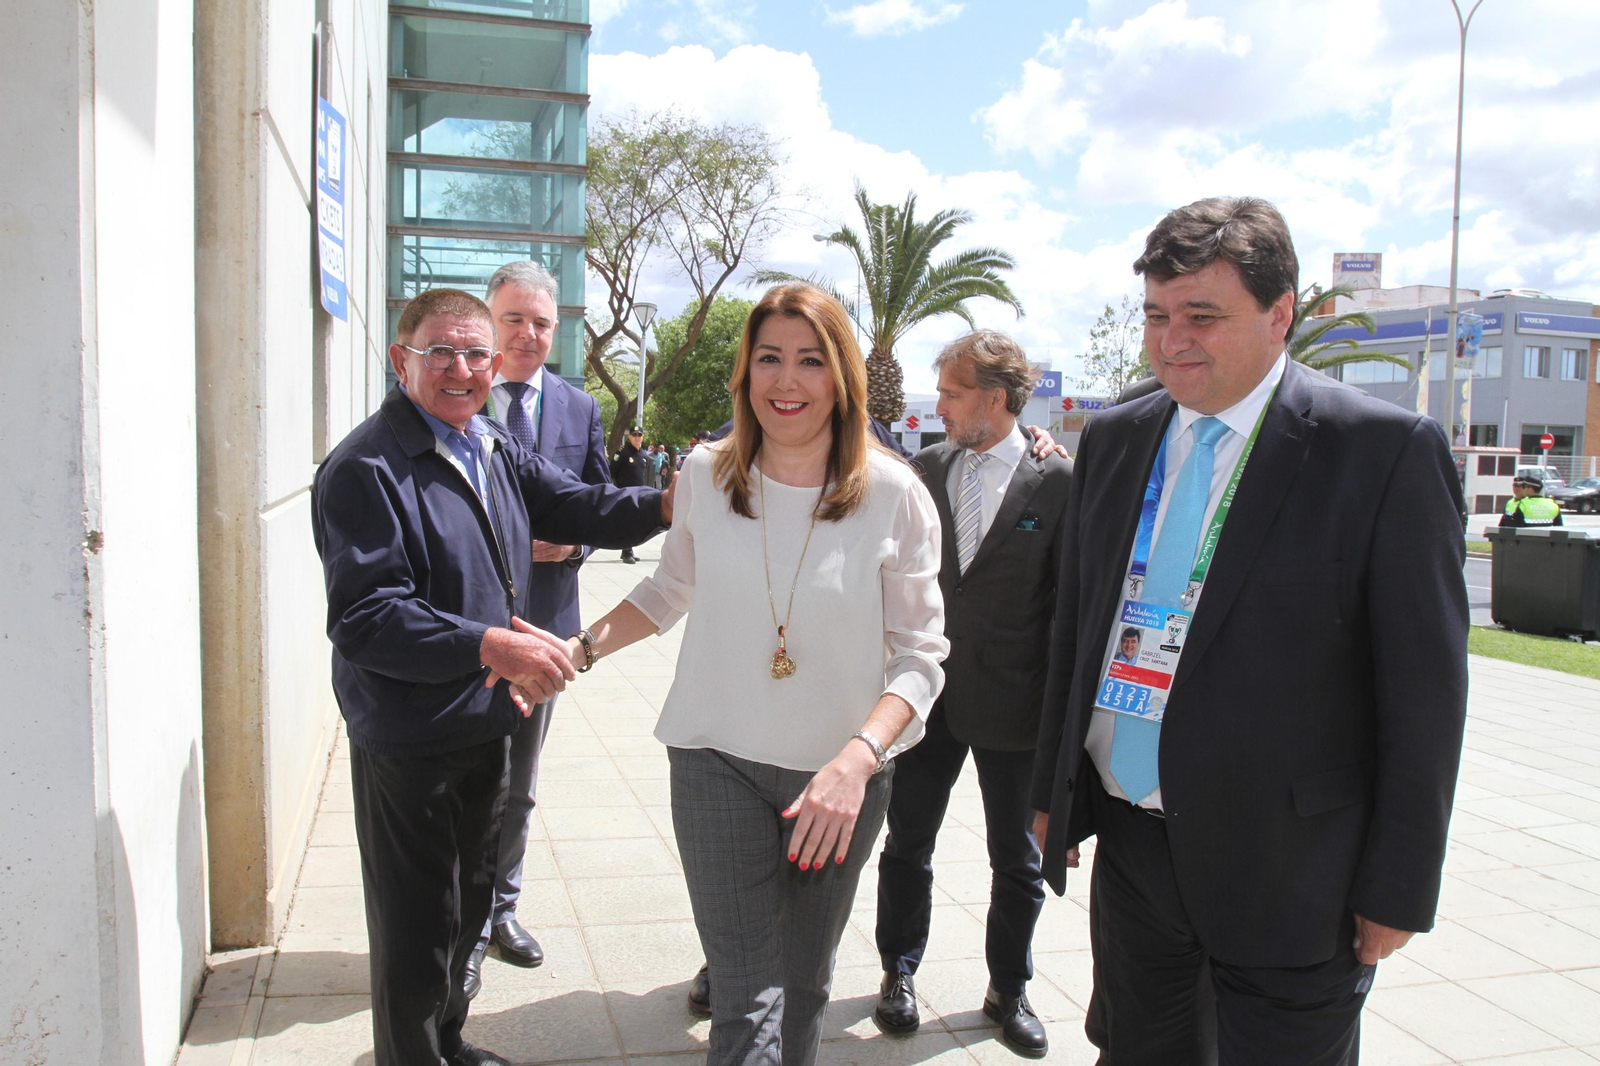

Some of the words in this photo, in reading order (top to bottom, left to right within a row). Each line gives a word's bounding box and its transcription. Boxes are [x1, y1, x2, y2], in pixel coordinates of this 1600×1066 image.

[1523, 317, 1550, 325] VOLVO
[1222, 482, 1238, 508] 2018
[1124, 615, 1145, 624] HUELVA
[1145, 618, 1160, 627] 2018
[1141, 649, 1162, 659] GABRIEL
